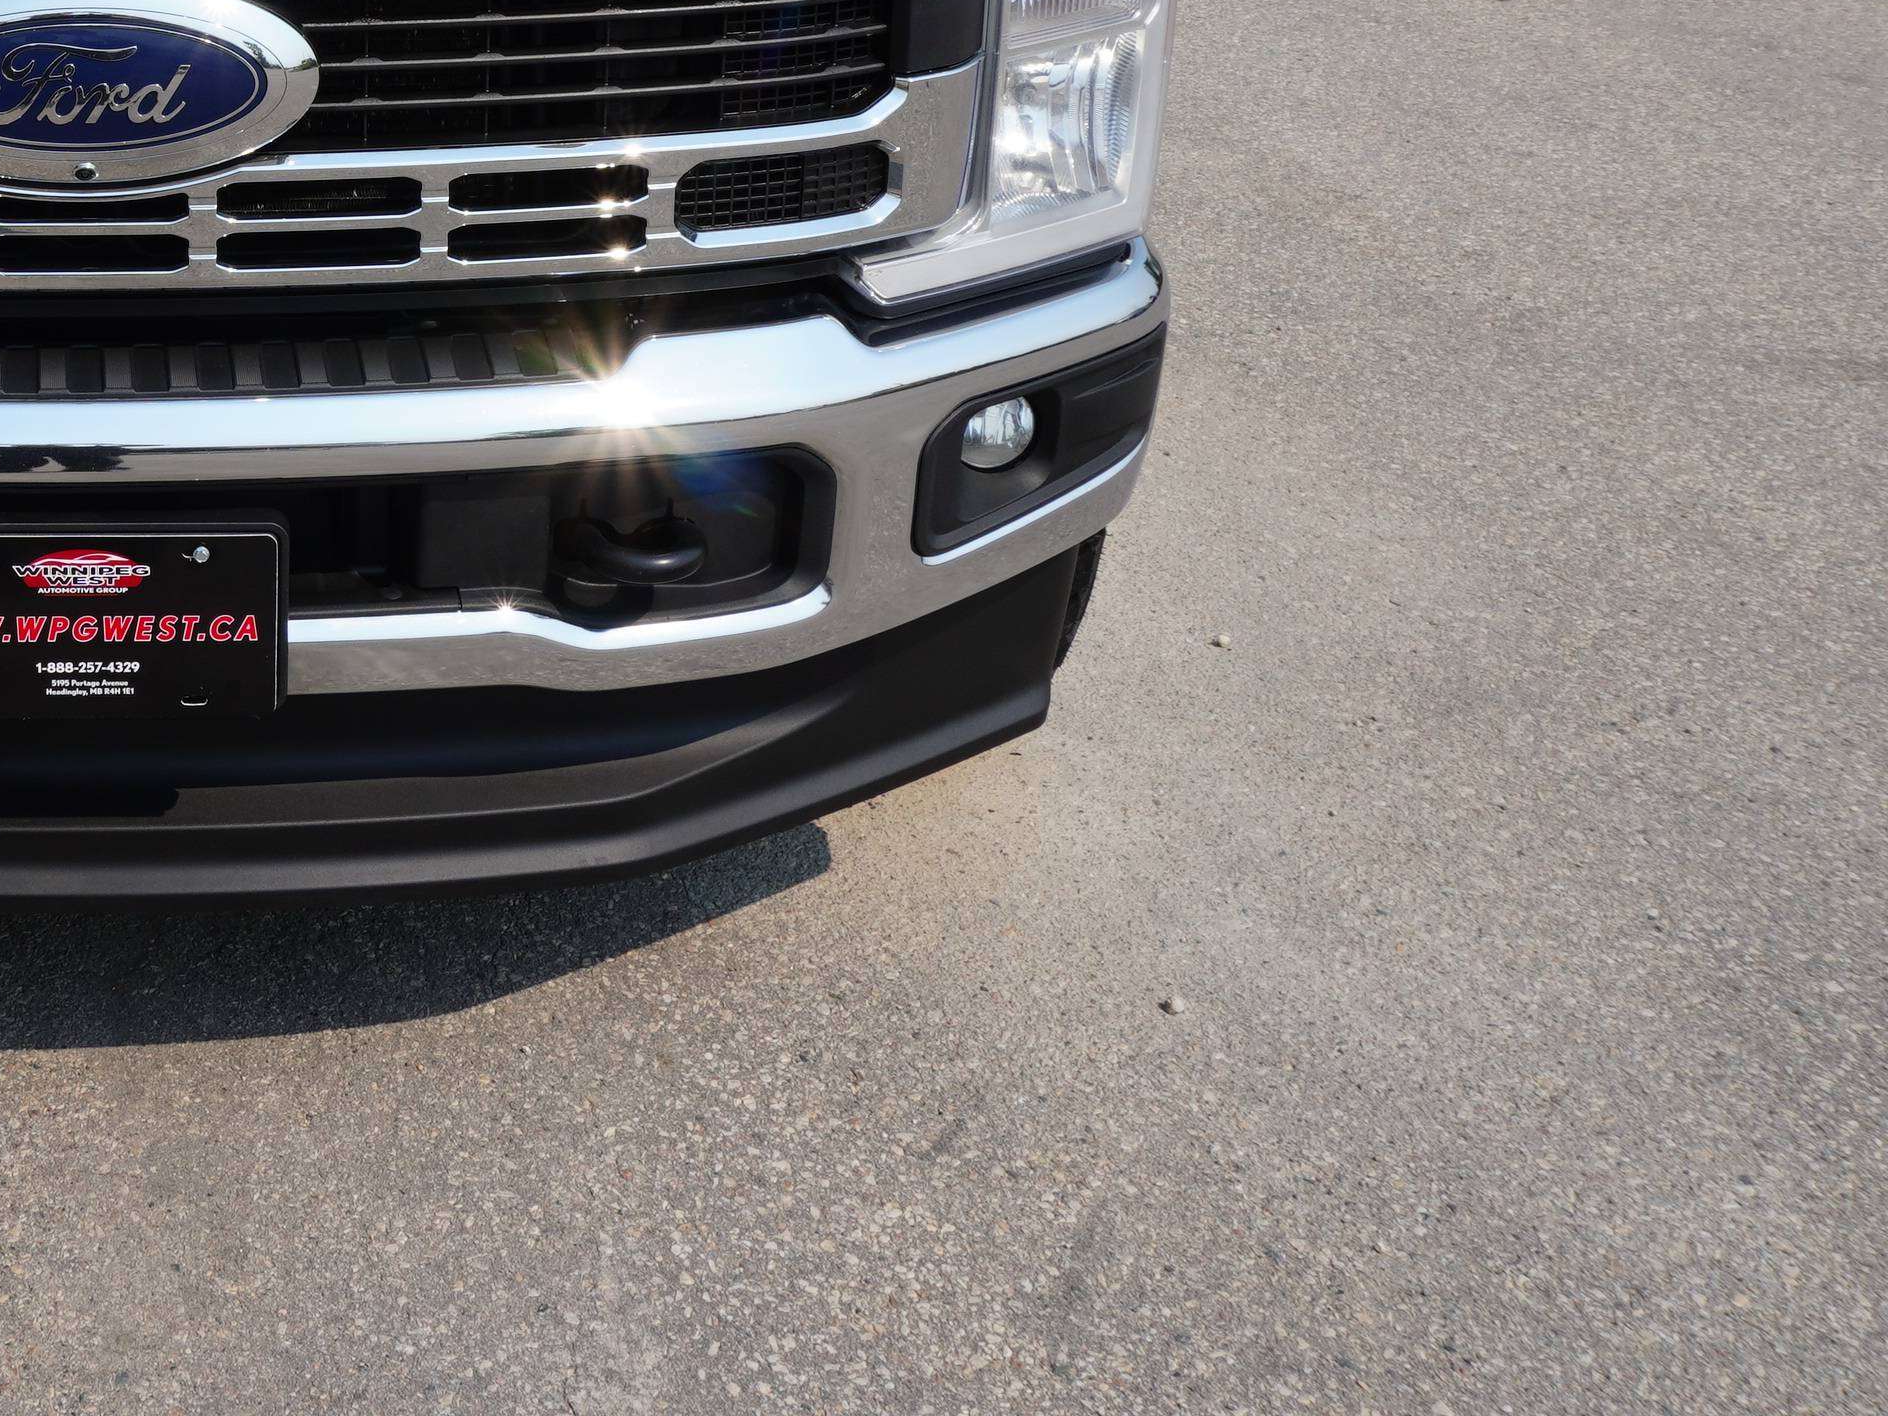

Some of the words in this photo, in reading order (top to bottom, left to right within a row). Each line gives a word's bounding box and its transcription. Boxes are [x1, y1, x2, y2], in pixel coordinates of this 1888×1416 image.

[11, 564, 151, 578] WINNIPEG
[45, 576, 121, 587] WEST
[35, 661, 141, 674] 1-888-257-4329
[51, 679, 70, 687] 5195
[71, 679, 101, 688] Portage
[101, 678, 129, 687] Avenue
[45, 687, 89, 697] Headingley,
[89, 687, 103, 695] MB
[104, 687, 121, 695] R4H
